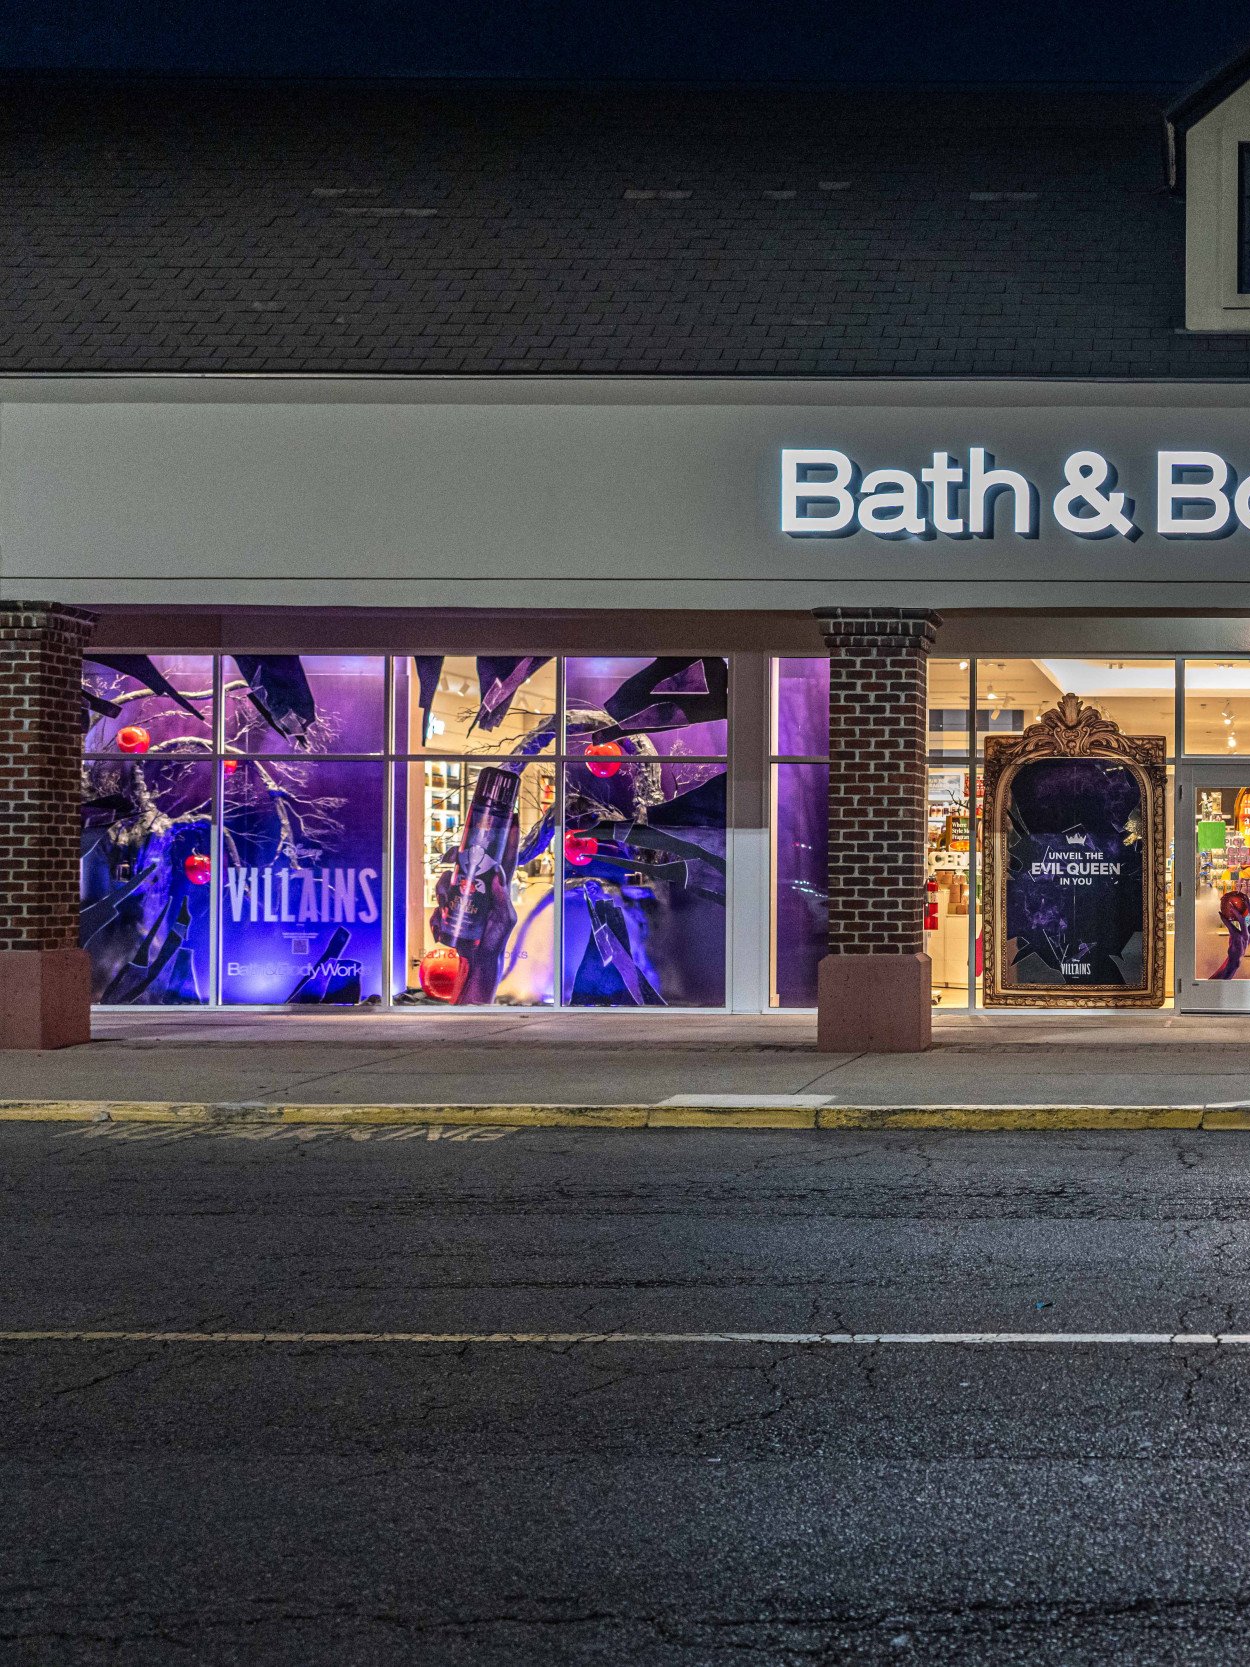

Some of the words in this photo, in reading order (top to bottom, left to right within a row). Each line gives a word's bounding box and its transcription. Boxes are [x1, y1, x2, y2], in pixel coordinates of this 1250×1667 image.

[782, 447, 1032, 535] Bath
[1053, 450, 1136, 537] &
[1048, 852, 1083, 860] UNVEIL
[1085, 852, 1104, 860] THE
[1031, 862, 1064, 875] EVIL
[1066, 862, 1121, 876] QUEEN
[225, 867, 379, 924] VILLAINS
[1061, 963, 1092, 975] VILLAINS
